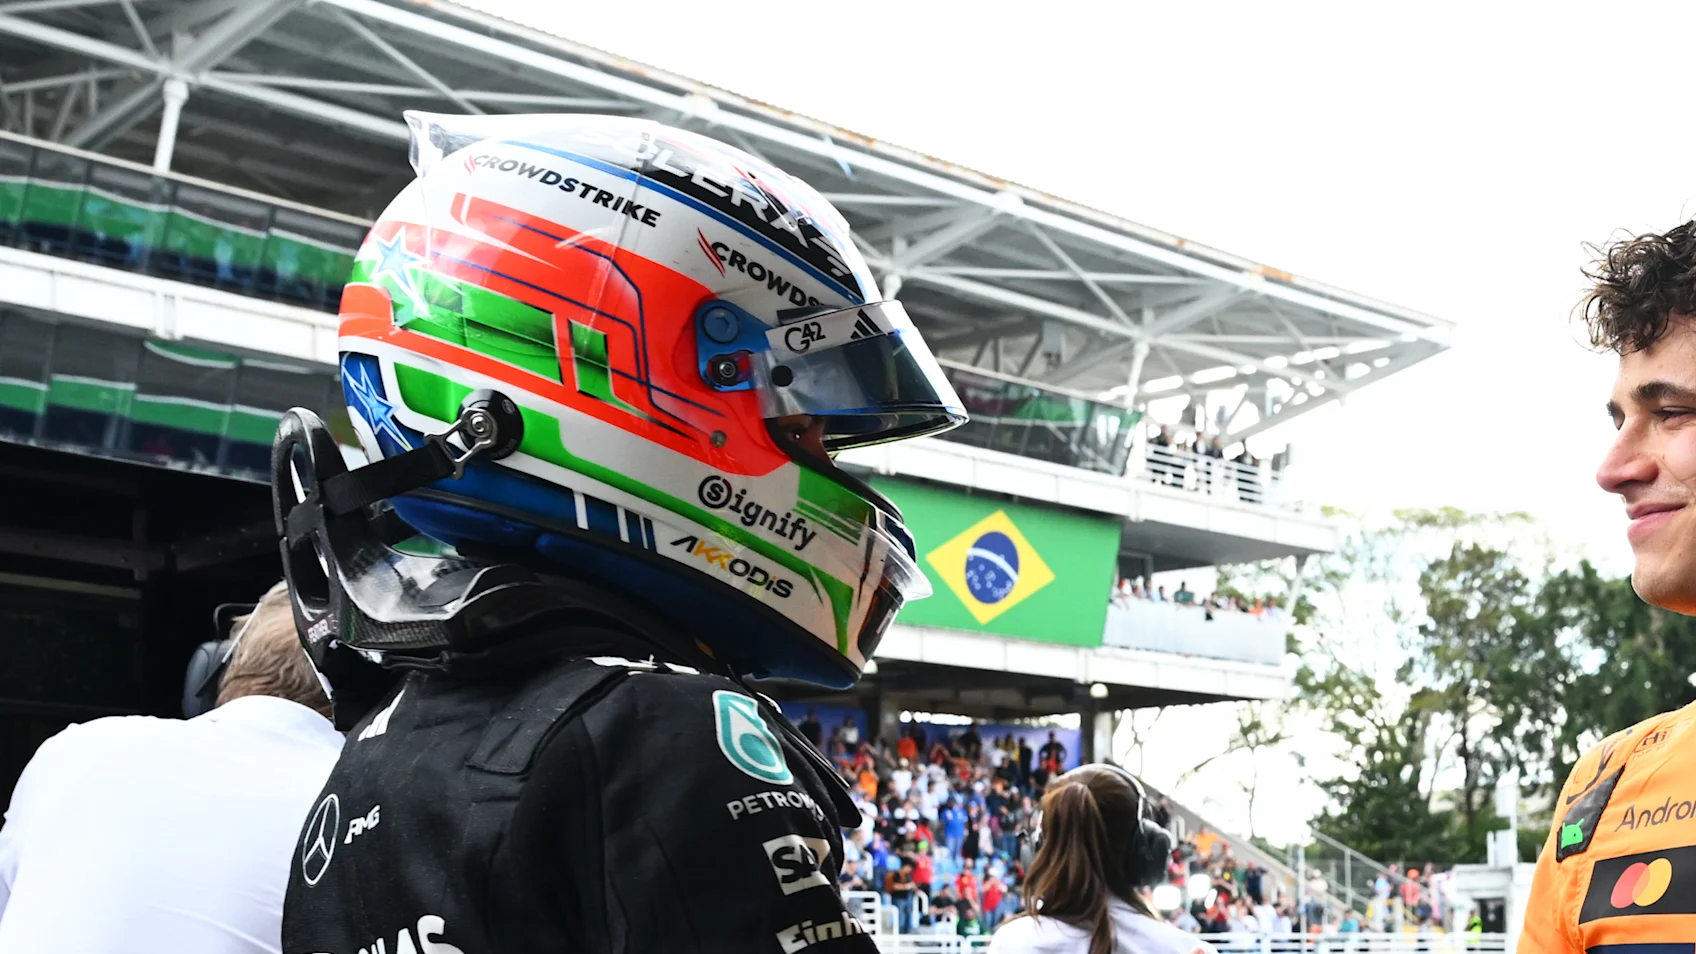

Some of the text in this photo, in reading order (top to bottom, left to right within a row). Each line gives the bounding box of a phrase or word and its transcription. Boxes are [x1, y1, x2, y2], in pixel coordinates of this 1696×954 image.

[473, 153, 661, 228] CROWDSTRIKE
[784, 321, 826, 353] G42
[343, 805, 381, 844] AMG
